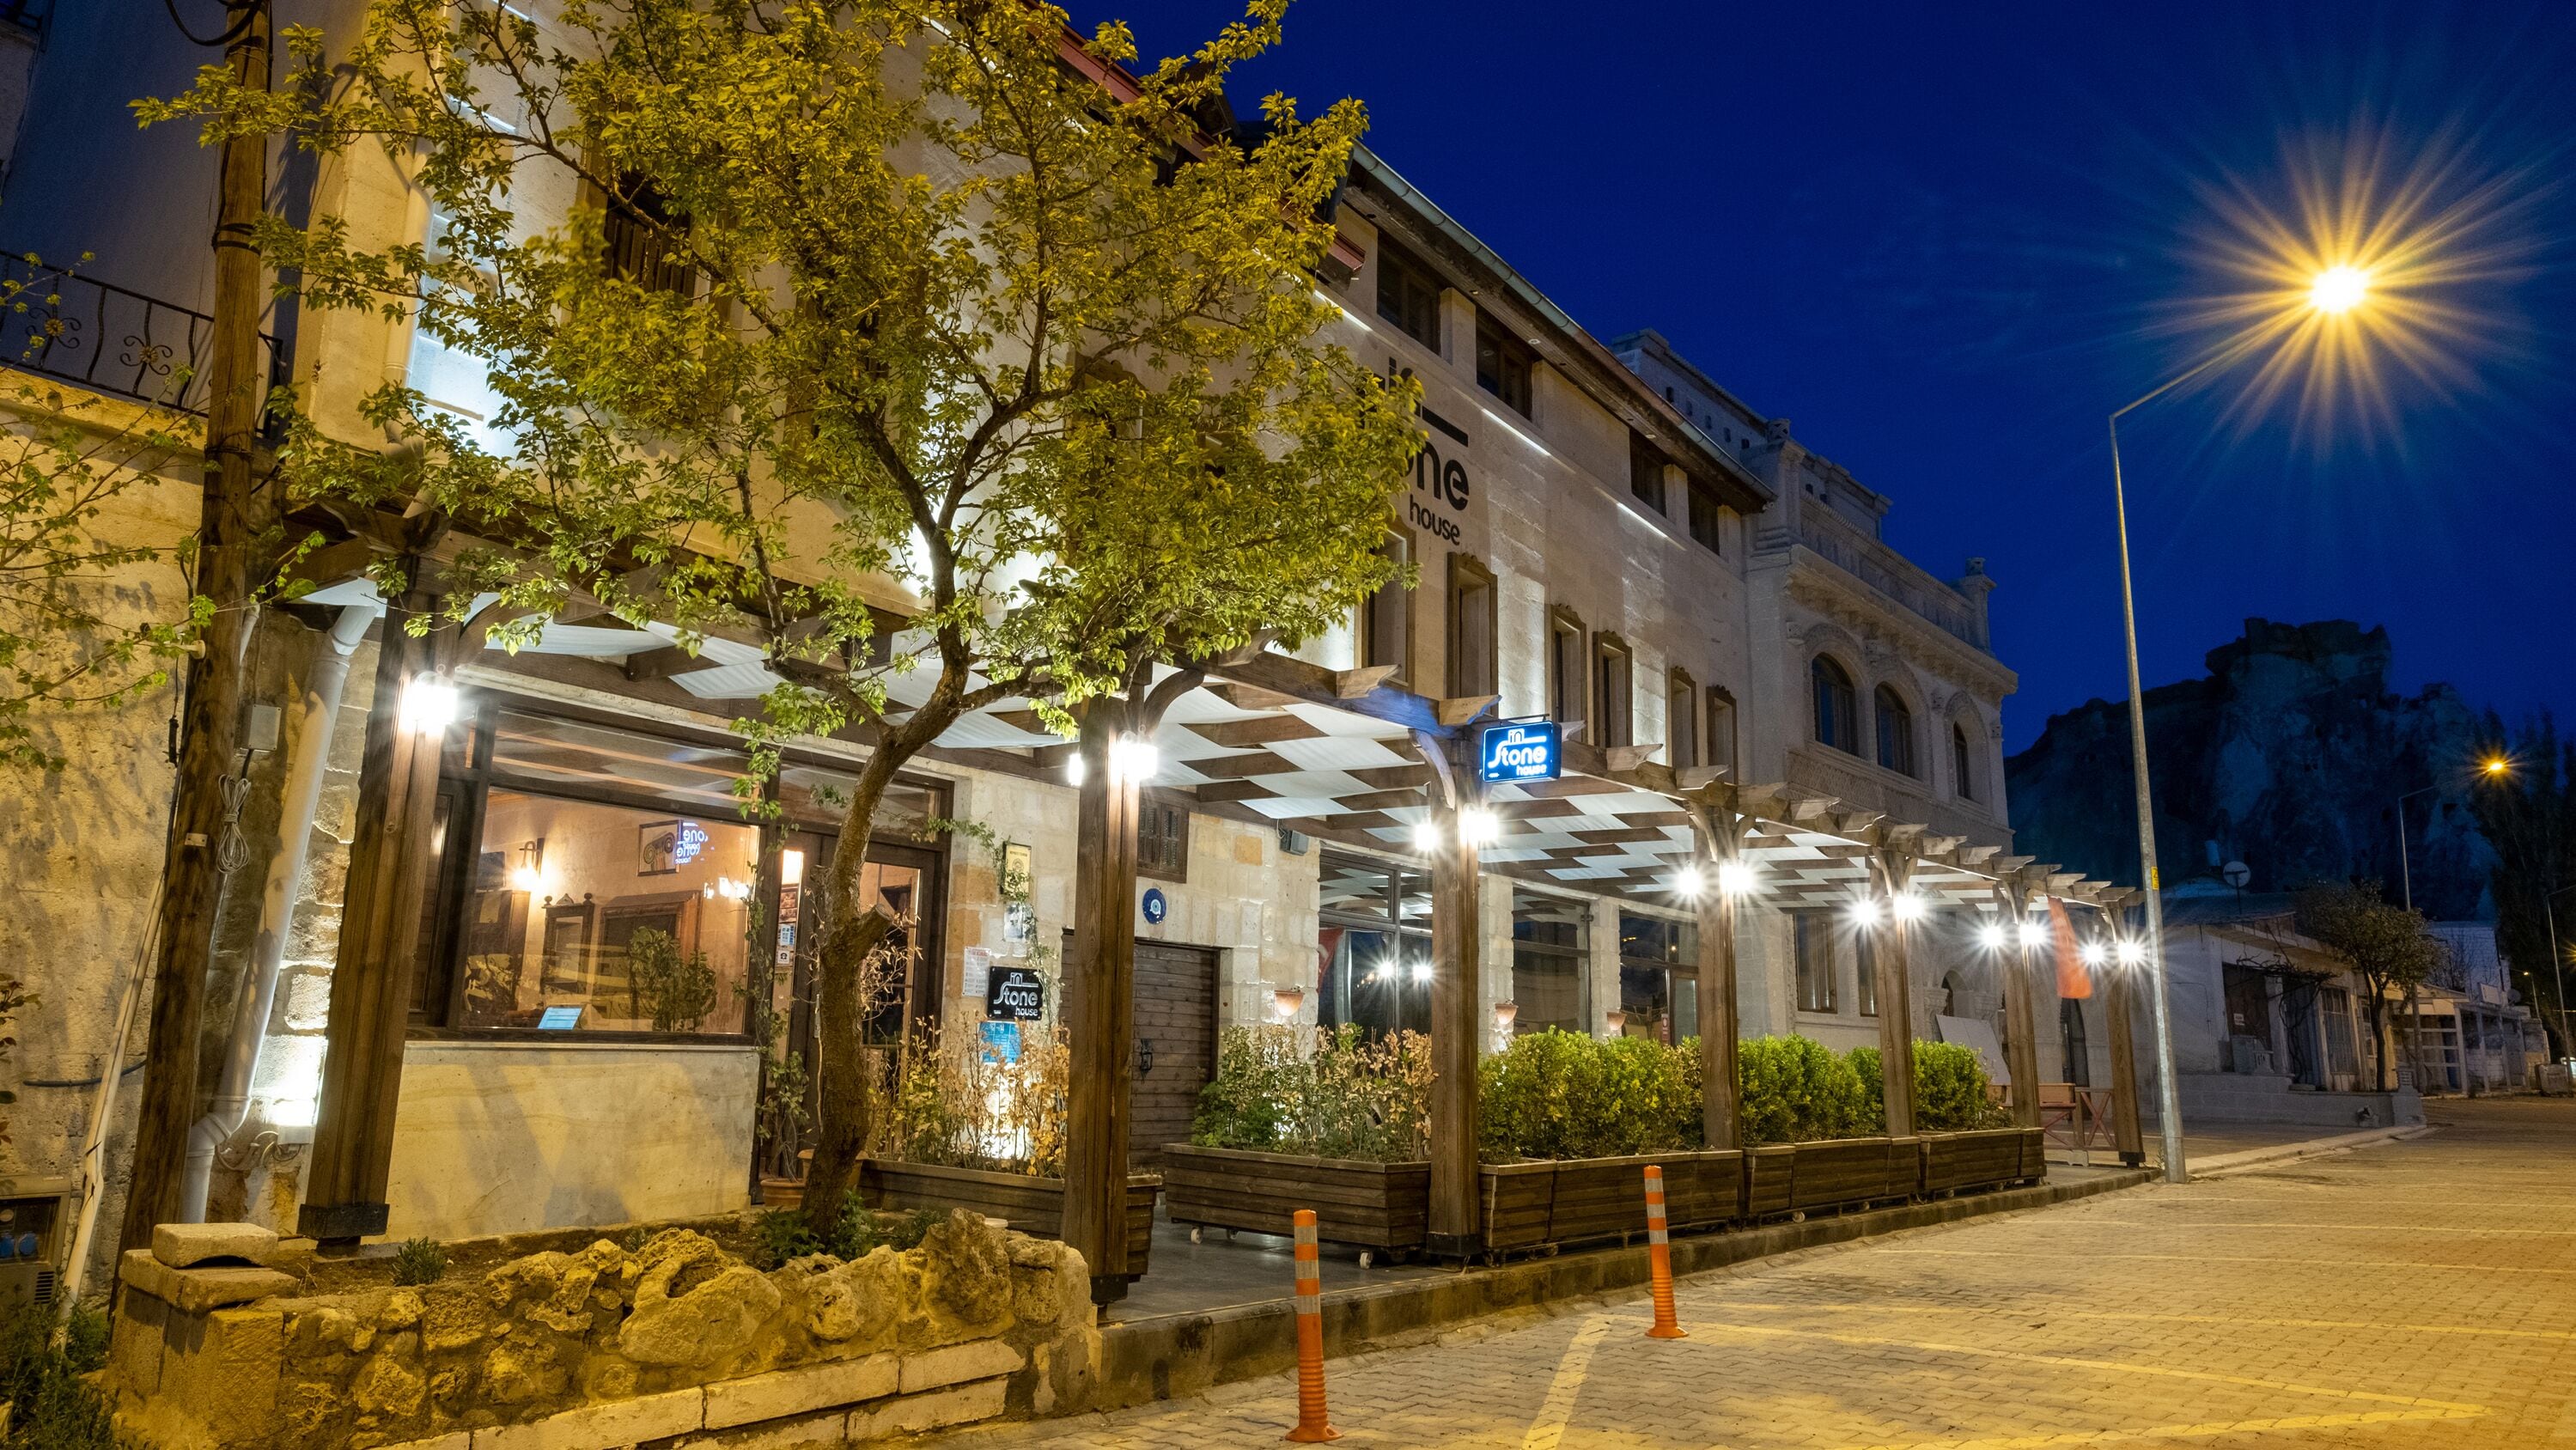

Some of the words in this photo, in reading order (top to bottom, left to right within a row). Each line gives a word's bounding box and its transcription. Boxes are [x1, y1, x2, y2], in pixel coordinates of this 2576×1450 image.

[1409, 494, 1460, 546] house
[1509, 730, 1523, 743] in
[1488, 736, 1547, 769] Stone
[1516, 765, 1547, 775] house
[1010, 972, 1022, 984] in
[994, 981, 1038, 1006] Stone
[1015, 1006, 1038, 1016] house
